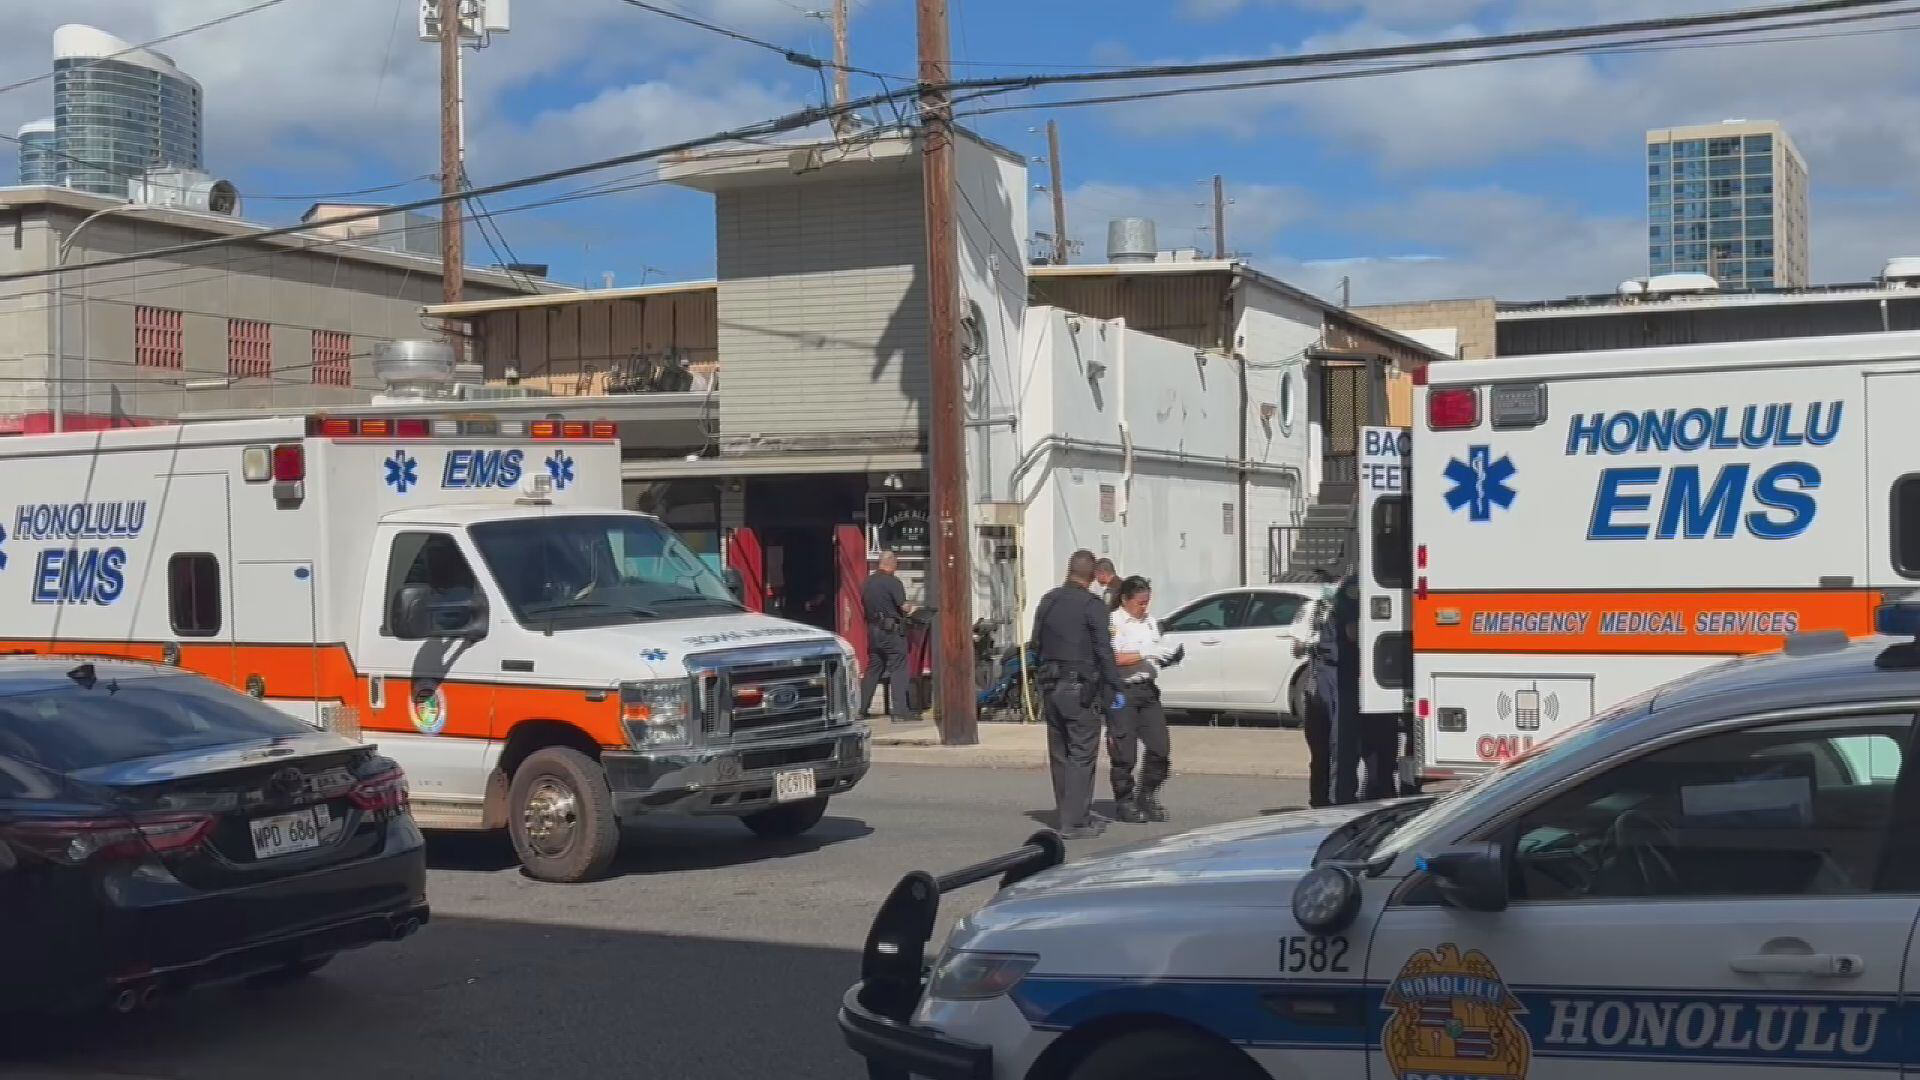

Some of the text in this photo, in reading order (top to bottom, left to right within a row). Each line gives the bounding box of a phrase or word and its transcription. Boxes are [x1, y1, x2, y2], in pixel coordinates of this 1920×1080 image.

[1565, 400, 1843, 456] HONOLULU
[441, 448, 525, 489] EMS
[13, 499, 147, 540] HONOLULU
[1586, 461, 1822, 541] EMS
[32, 547, 126, 605] EMS
[1470, 611, 1799, 636] EMERGENCY MEDICAL SERVICES
[289, 819, 315, 841] 686
[1278, 936, 1350, 973] 1582
[1401, 975, 1500, 999] HONOLULU
[1545, 1000, 1886, 1055] HONOLULU
